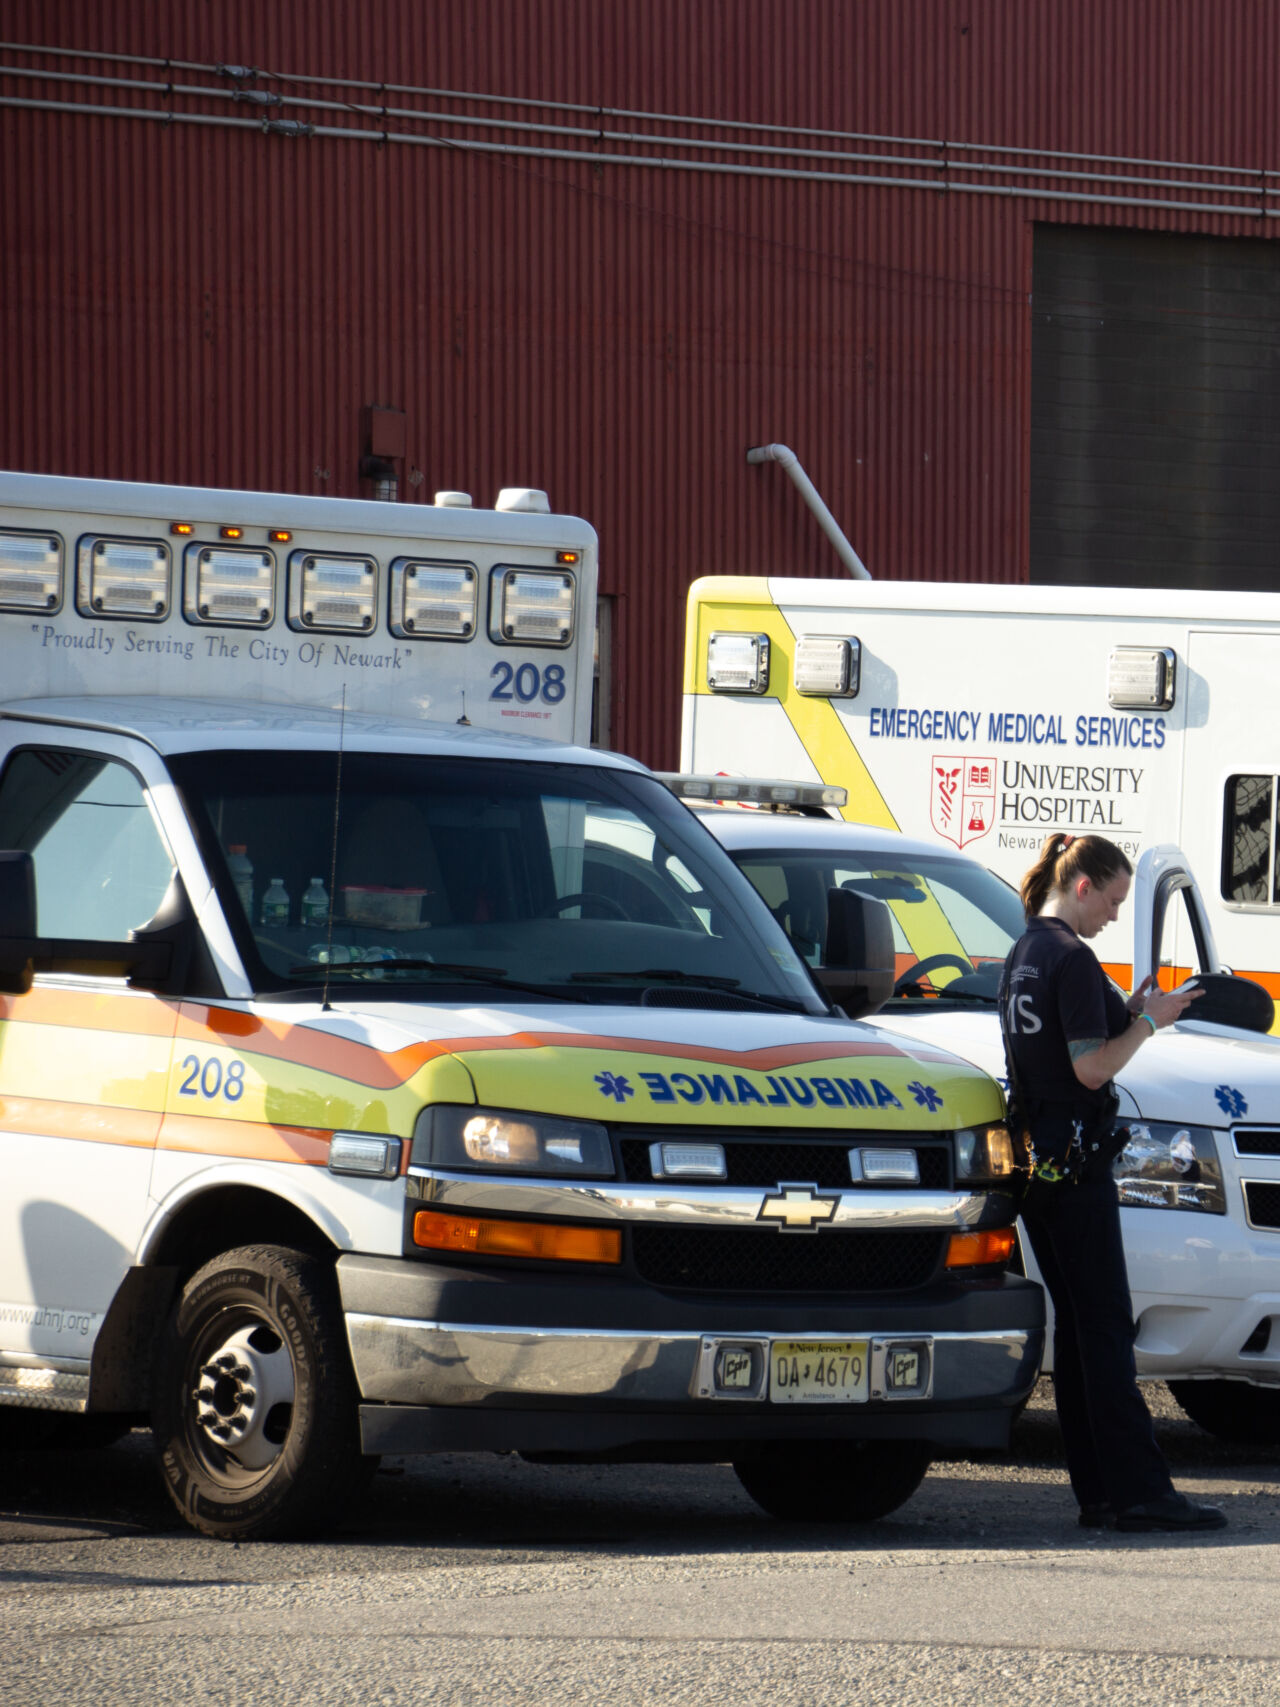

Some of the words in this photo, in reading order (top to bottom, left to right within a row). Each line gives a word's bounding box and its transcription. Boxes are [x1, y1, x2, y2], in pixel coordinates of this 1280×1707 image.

[31, 624, 115, 655] "Proudly
[124, 630, 194, 660] Serving
[204, 635, 239, 658] The
[248, 639, 289, 666] City
[299, 642, 324, 668] Of
[334, 644, 412, 669] Newark"
[488, 661, 566, 706] 208
[869, 707, 981, 741] EMERGENCY
[987, 712, 1067, 745] MEDICAL
[1075, 715, 1166, 749] SERVICES
[1002, 760, 1144, 793] UNIVERSITY
[1000, 792, 1123, 825] HOSPITAL
[998, 832, 1047, 850] Newar
[178, 1054, 246, 1103] 208
[796, 1343, 815, 1352] New
[817, 1343, 844, 1355] Jersey
[814, 1356, 862, 1387] 4679
